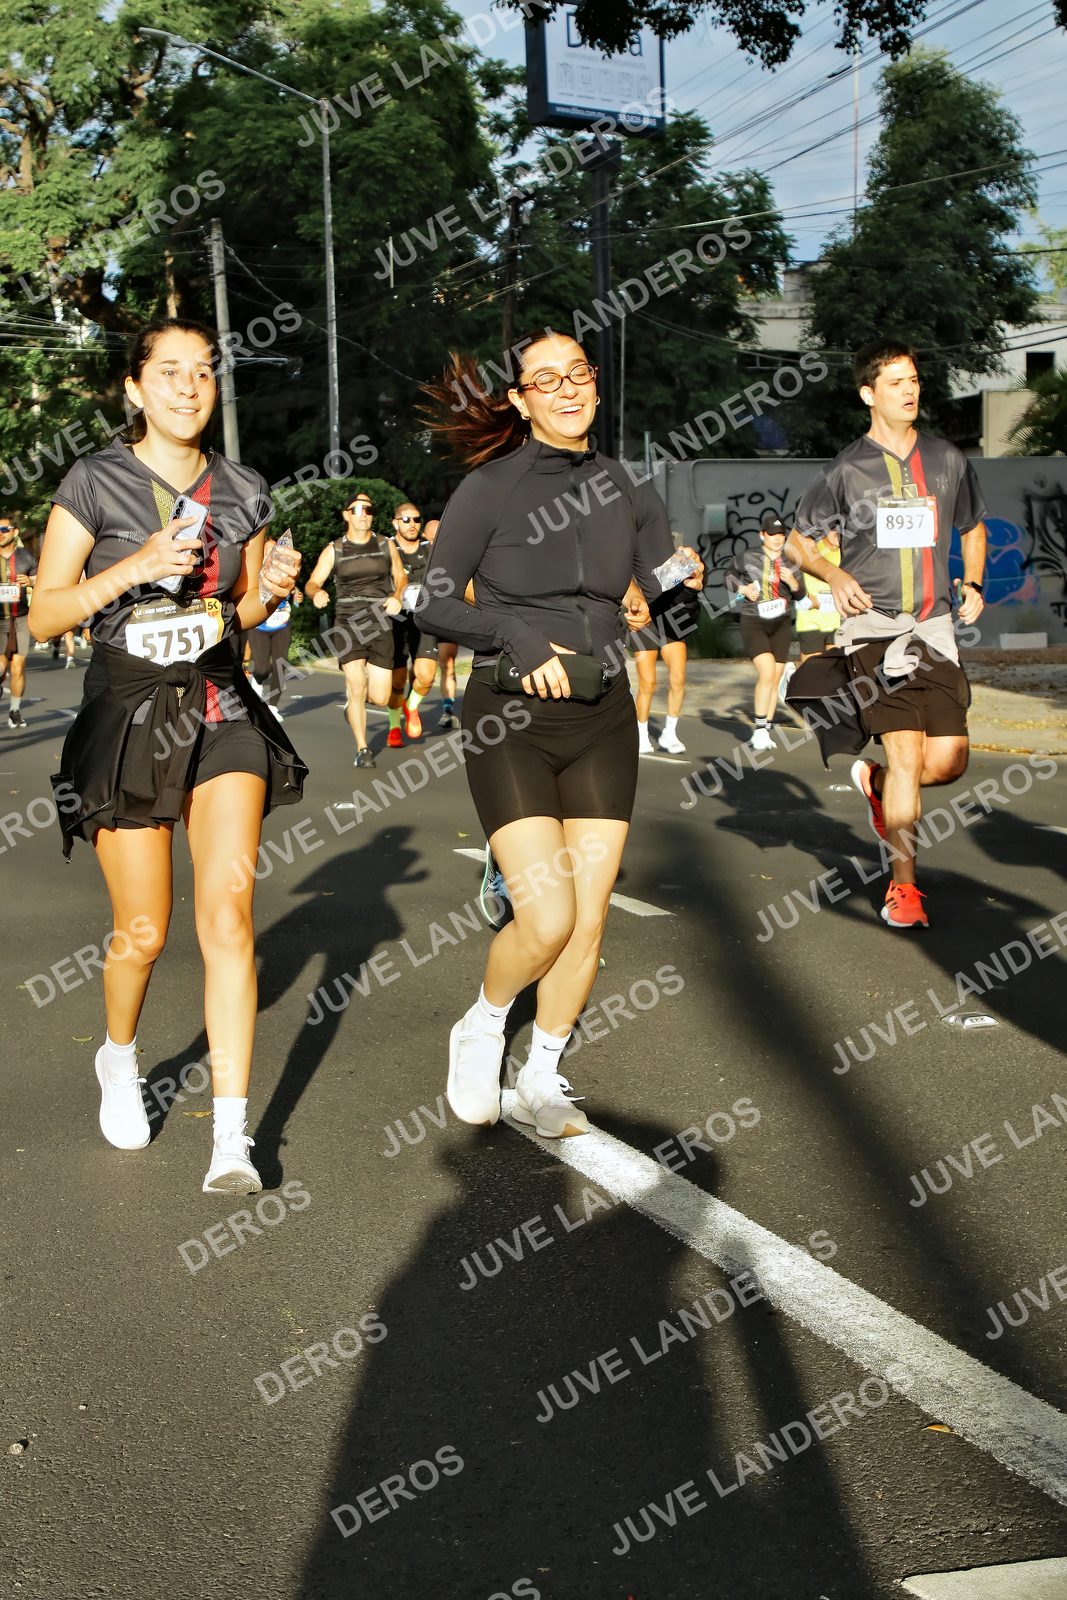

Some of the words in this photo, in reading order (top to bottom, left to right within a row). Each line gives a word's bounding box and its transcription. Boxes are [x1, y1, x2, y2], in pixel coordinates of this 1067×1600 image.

[727, 487, 790, 512] TOY
[886, 514, 925, 530] 8937
[142, 625, 206, 660] 5751
